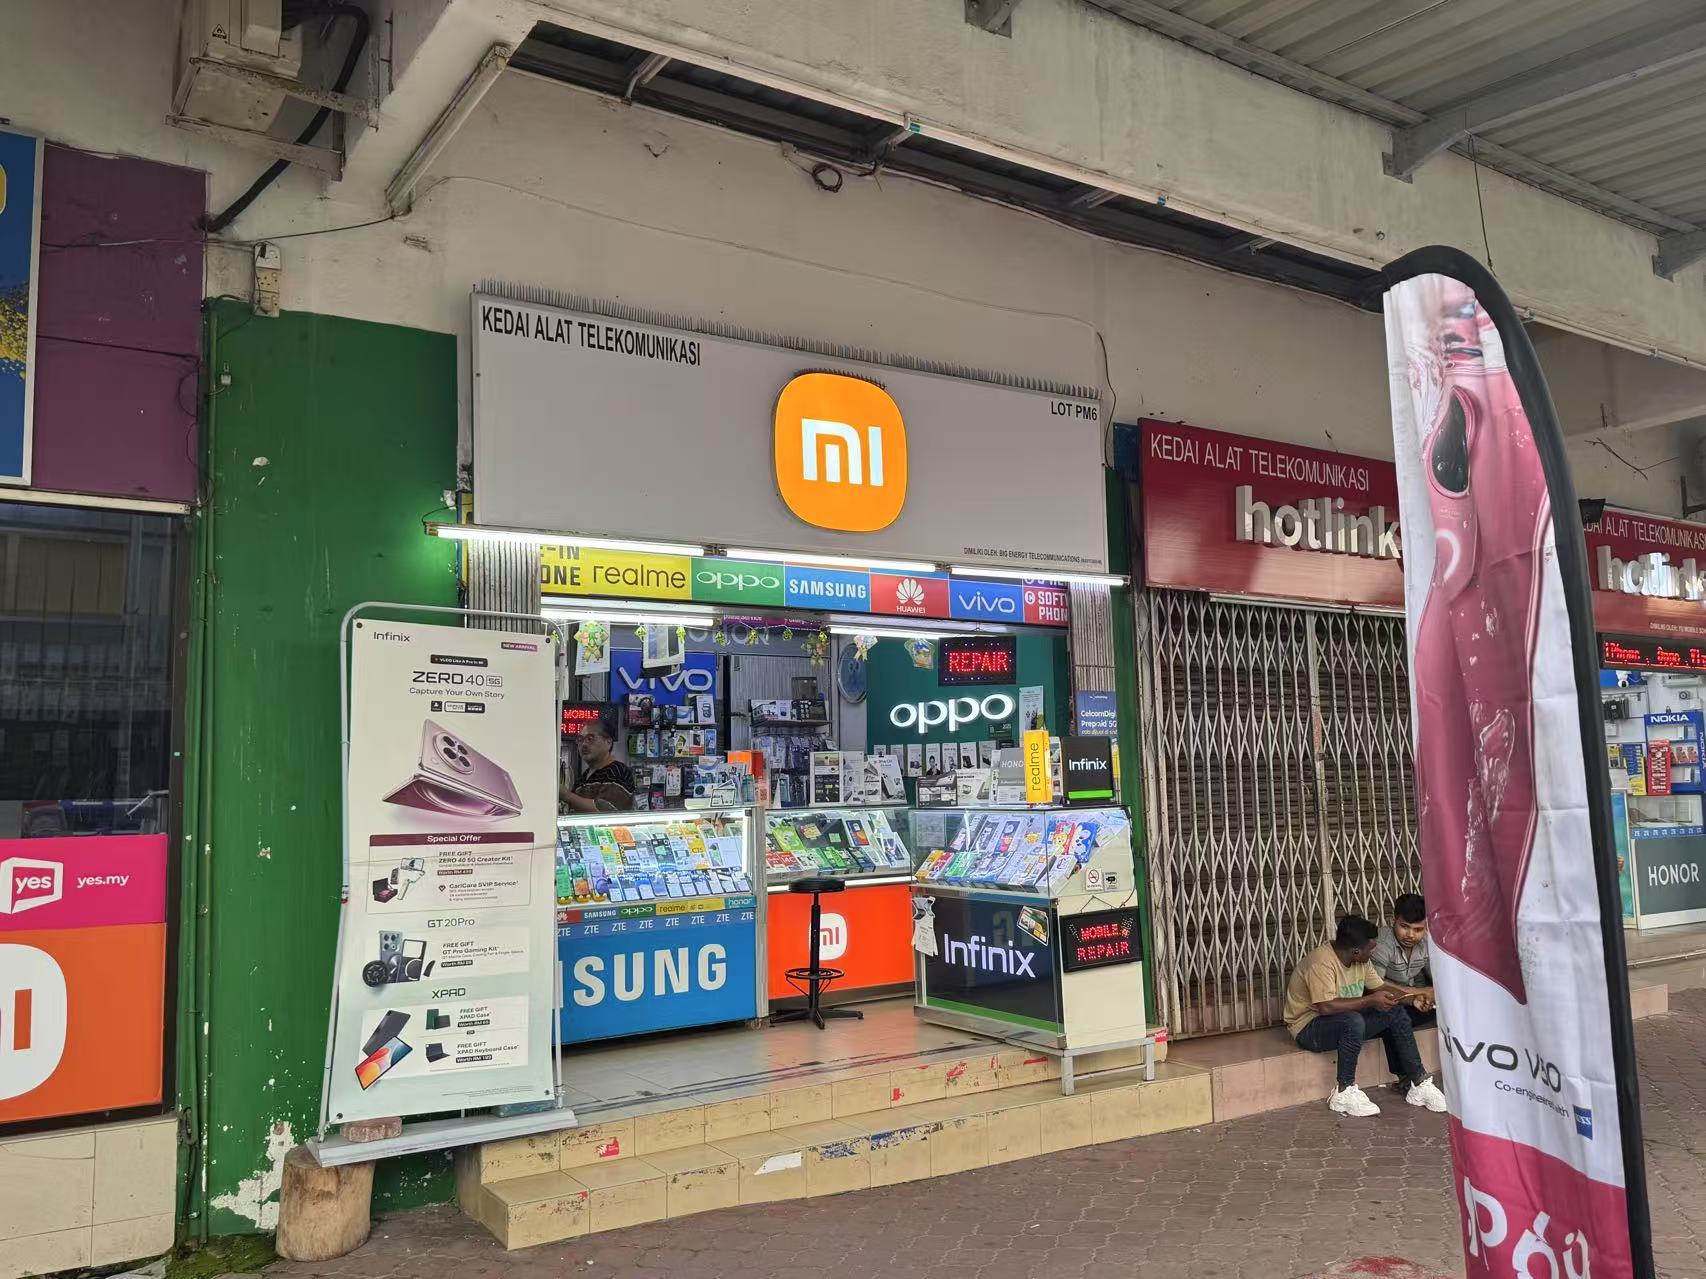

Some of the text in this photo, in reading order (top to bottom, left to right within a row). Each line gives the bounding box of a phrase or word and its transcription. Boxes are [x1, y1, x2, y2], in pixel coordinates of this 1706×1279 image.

[482, 305, 701, 366] KEDAI ALAT TELEKOMUNIKASI
[1051, 400, 1098, 421] LOT PM6
[1151, 432, 1369, 492] KEDAI ALAT TELEKOMUNIKASI
[1236, 484, 1402, 559] hotlink
[1606, 516, 1630, 538] ALAT
[1009, 551, 1029, 559] ENERGY
[1029, 552, 1081, 563] TELECOMMUNICATIONS
[593, 564, 686, 589] realme
[696, 570, 780, 591] oppo
[788, 578, 867, 599] SAMSUNG
[958, 591, 1015, 612] vivo
[1037, 591, 1065, 606] SOFT
[896, 605, 926, 614] HUAWEI
[373, 631, 411, 642] Infinix
[949, 651, 1009, 673] REPAIR
[488, 677, 501, 686] 5G
[618, 667, 713, 692] vivo
[409, 687, 443, 697] Capture
[445, 688, 464, 696] Your
[484, 691, 505, 699] Story
[563, 709, 599, 719] MOBILE
[889, 693, 1014, 734] oppo
[1650, 714, 1689, 723] NOKIA
[1081, 720, 1107, 728] Prepaid
[1001, 760, 1024, 769] HONO
[1029, 742, 1041, 791] realme
[1068, 757, 1108, 771] Infinix
[427, 833, 482, 843] Special Offer
[77, 874, 129, 888] yes.my
[1648, 862, 1700, 886] HONOR
[15, 875, 52, 894] yes
[584, 910, 617, 919] SAMSUNG
[621, 906, 654, 916] oppo
[659, 903, 686, 913] realme
[557, 911, 754, 936] ZTE ZTE ZTE ZTE ZTE ZTE ZTE ZTE
[1080, 923, 1119, 942] MOBILE
[944, 933, 1036, 978] Infinix
[1077, 942, 1130, 961] REPAIR
[558, 943, 727, 1009] SUNG
[432, 988, 466, 999] XPAD
